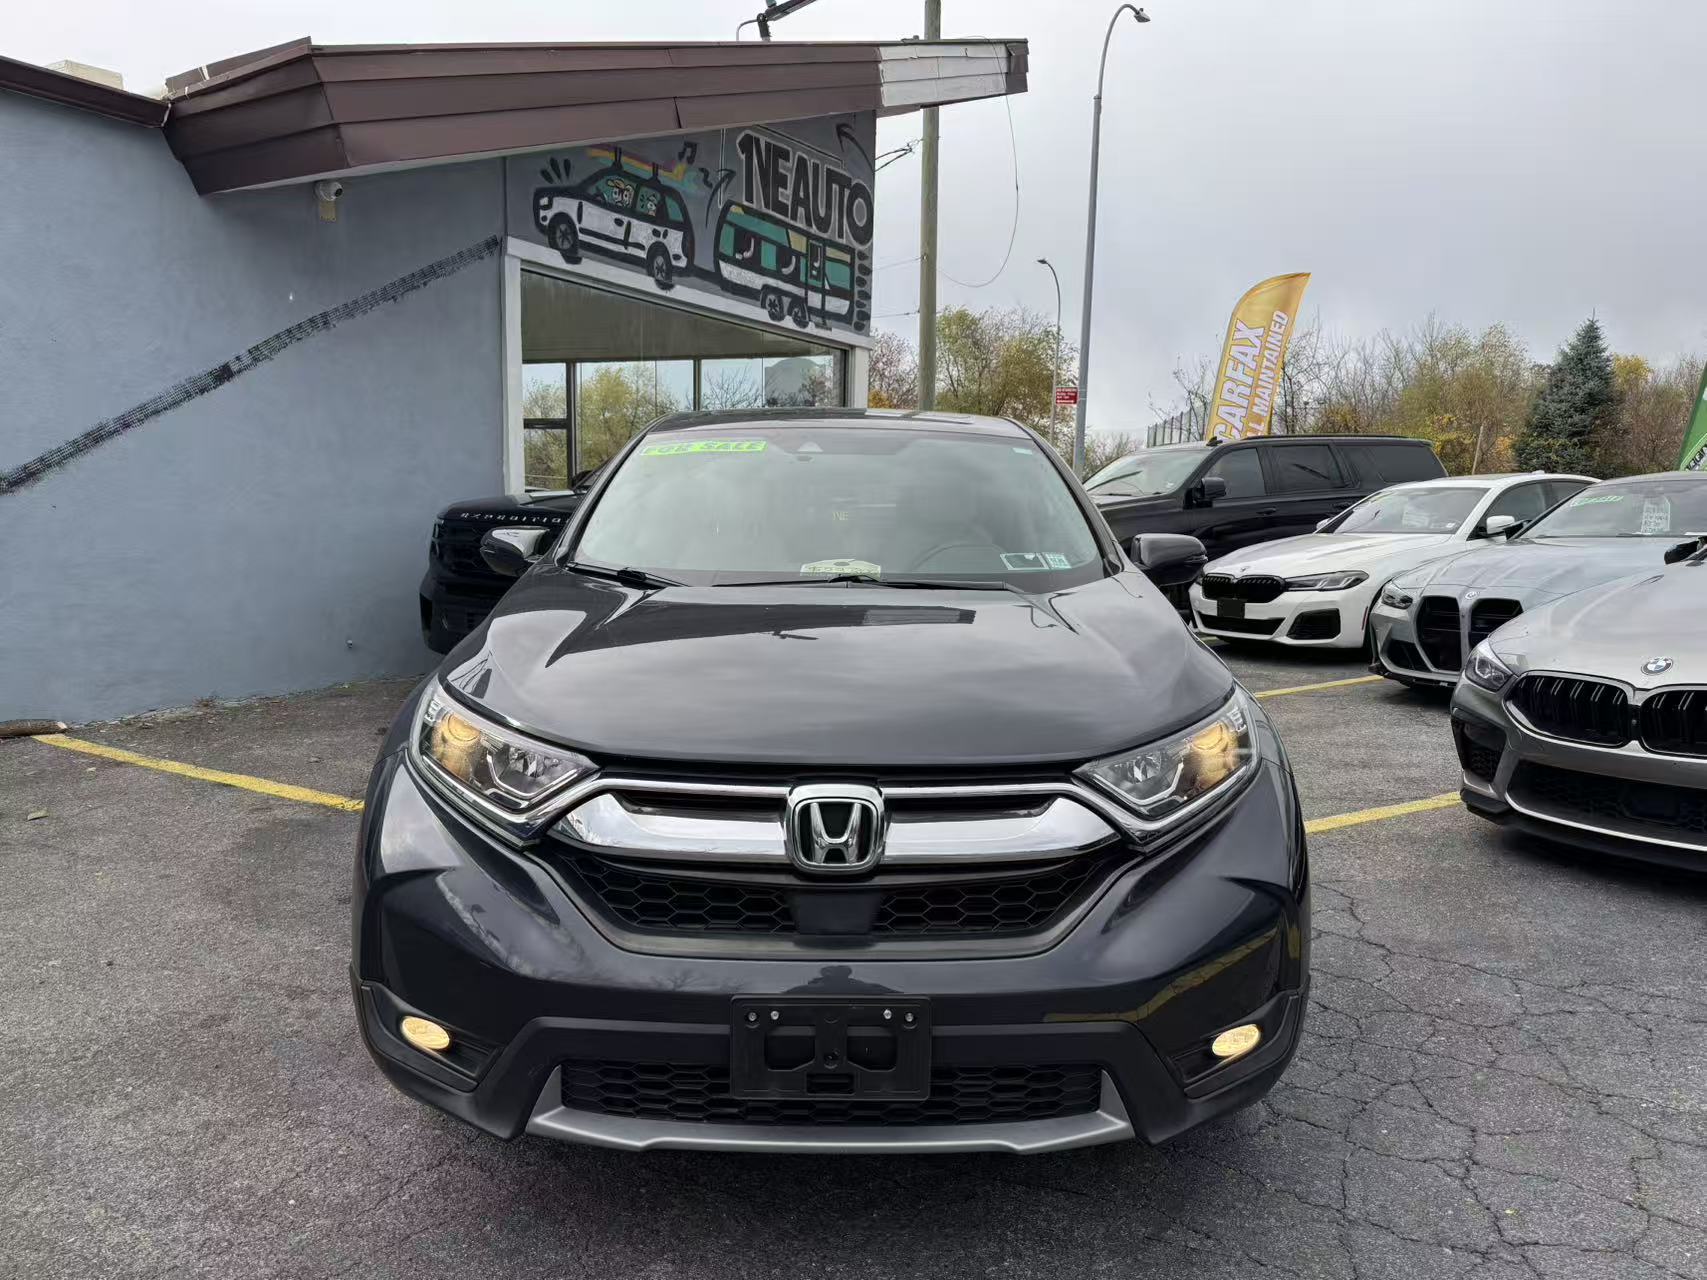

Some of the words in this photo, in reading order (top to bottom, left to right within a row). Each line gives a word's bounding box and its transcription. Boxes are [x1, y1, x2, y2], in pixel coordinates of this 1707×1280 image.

[1212, 319, 1265, 440] CARFAX
[1252, 309, 1290, 417] MAINTAINED
[460, 512, 571, 524] EXPEDITIO
